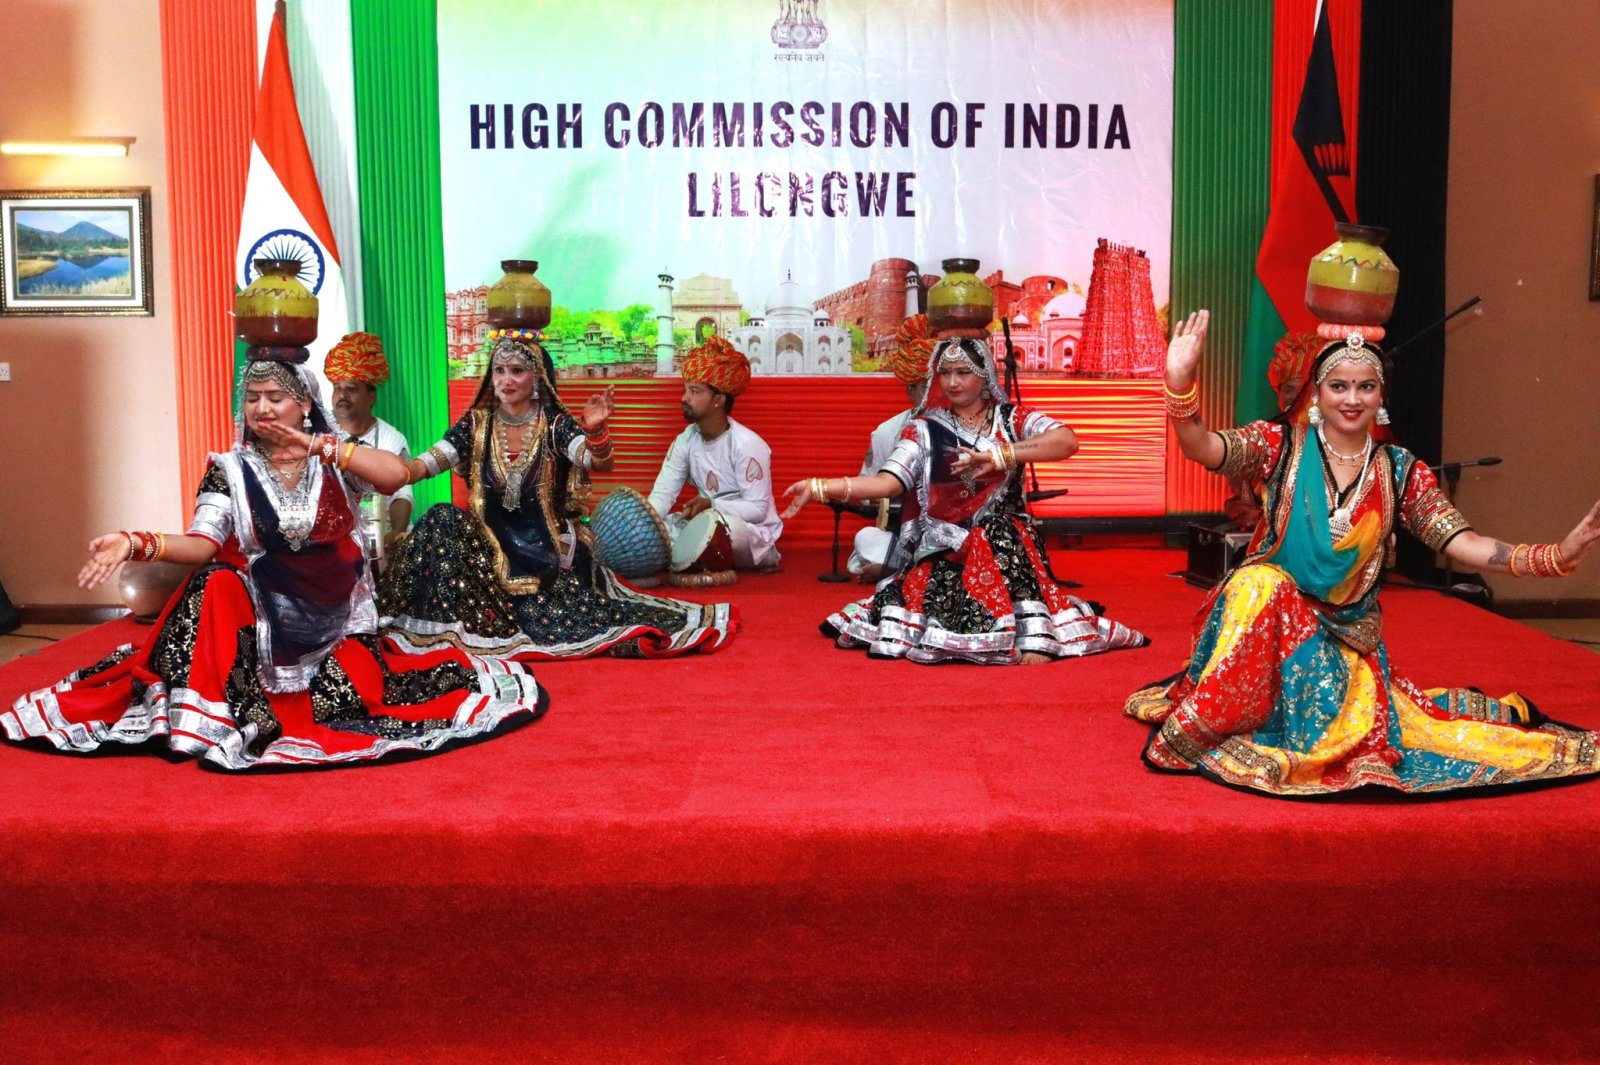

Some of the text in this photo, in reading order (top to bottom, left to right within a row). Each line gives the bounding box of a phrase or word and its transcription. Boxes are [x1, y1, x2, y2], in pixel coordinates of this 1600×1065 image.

[470, 102, 1131, 149] HIGH COMMISSION OF INDIA
